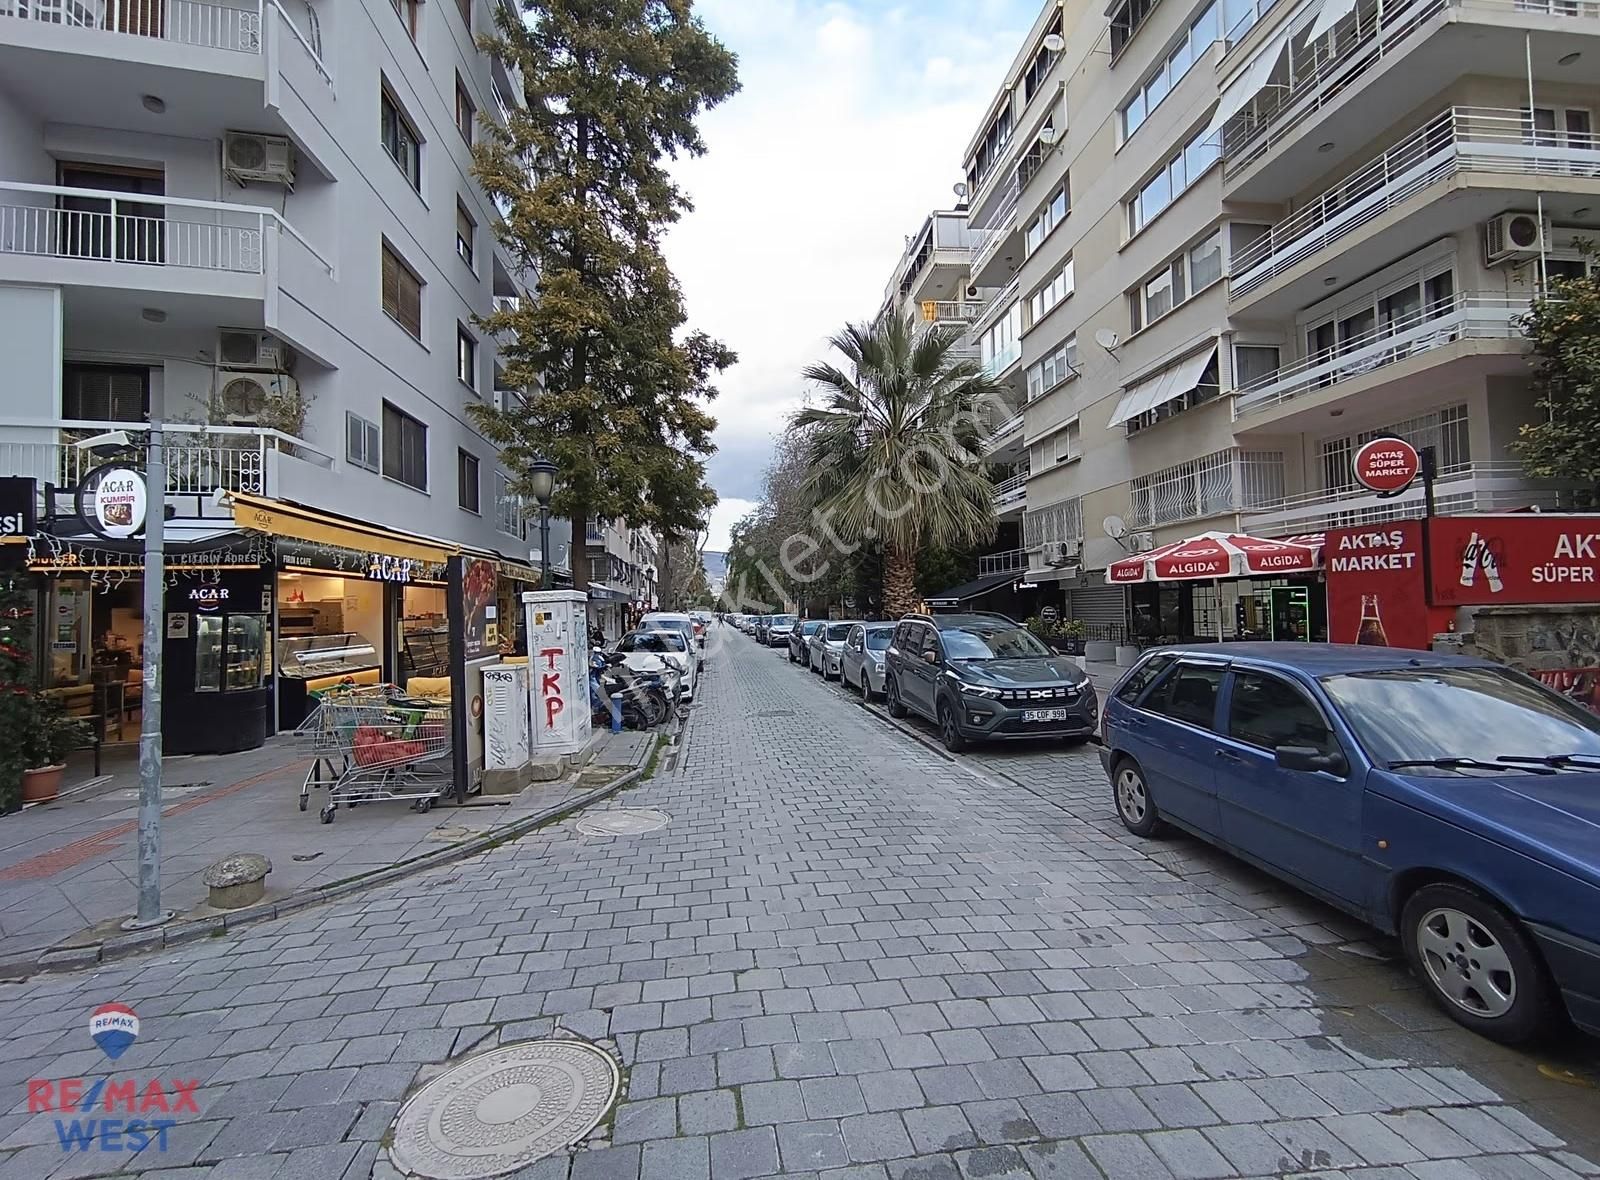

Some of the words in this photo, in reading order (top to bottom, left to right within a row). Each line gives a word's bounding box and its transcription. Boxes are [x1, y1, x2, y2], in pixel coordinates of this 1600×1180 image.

[1369, 450, 1404, 460] AKTAŞ
[1369, 460, 1404, 468] SÜPER
[1365, 468, 1410, 477] MARKET
[102, 480, 134, 493] ACAR
[1339, 530, 1404, 550] AKTAŞ
[1553, 534, 1600, 559] AK
[369, 553, 411, 582] ACAR
[1331, 552, 1416, 572] MARKET
[1531, 562, 1594, 583] SÜPER
[189, 588, 229, 599] ACAR
[539, 648, 564, 729] TKP
[1025, 711, 1034, 719] 35
